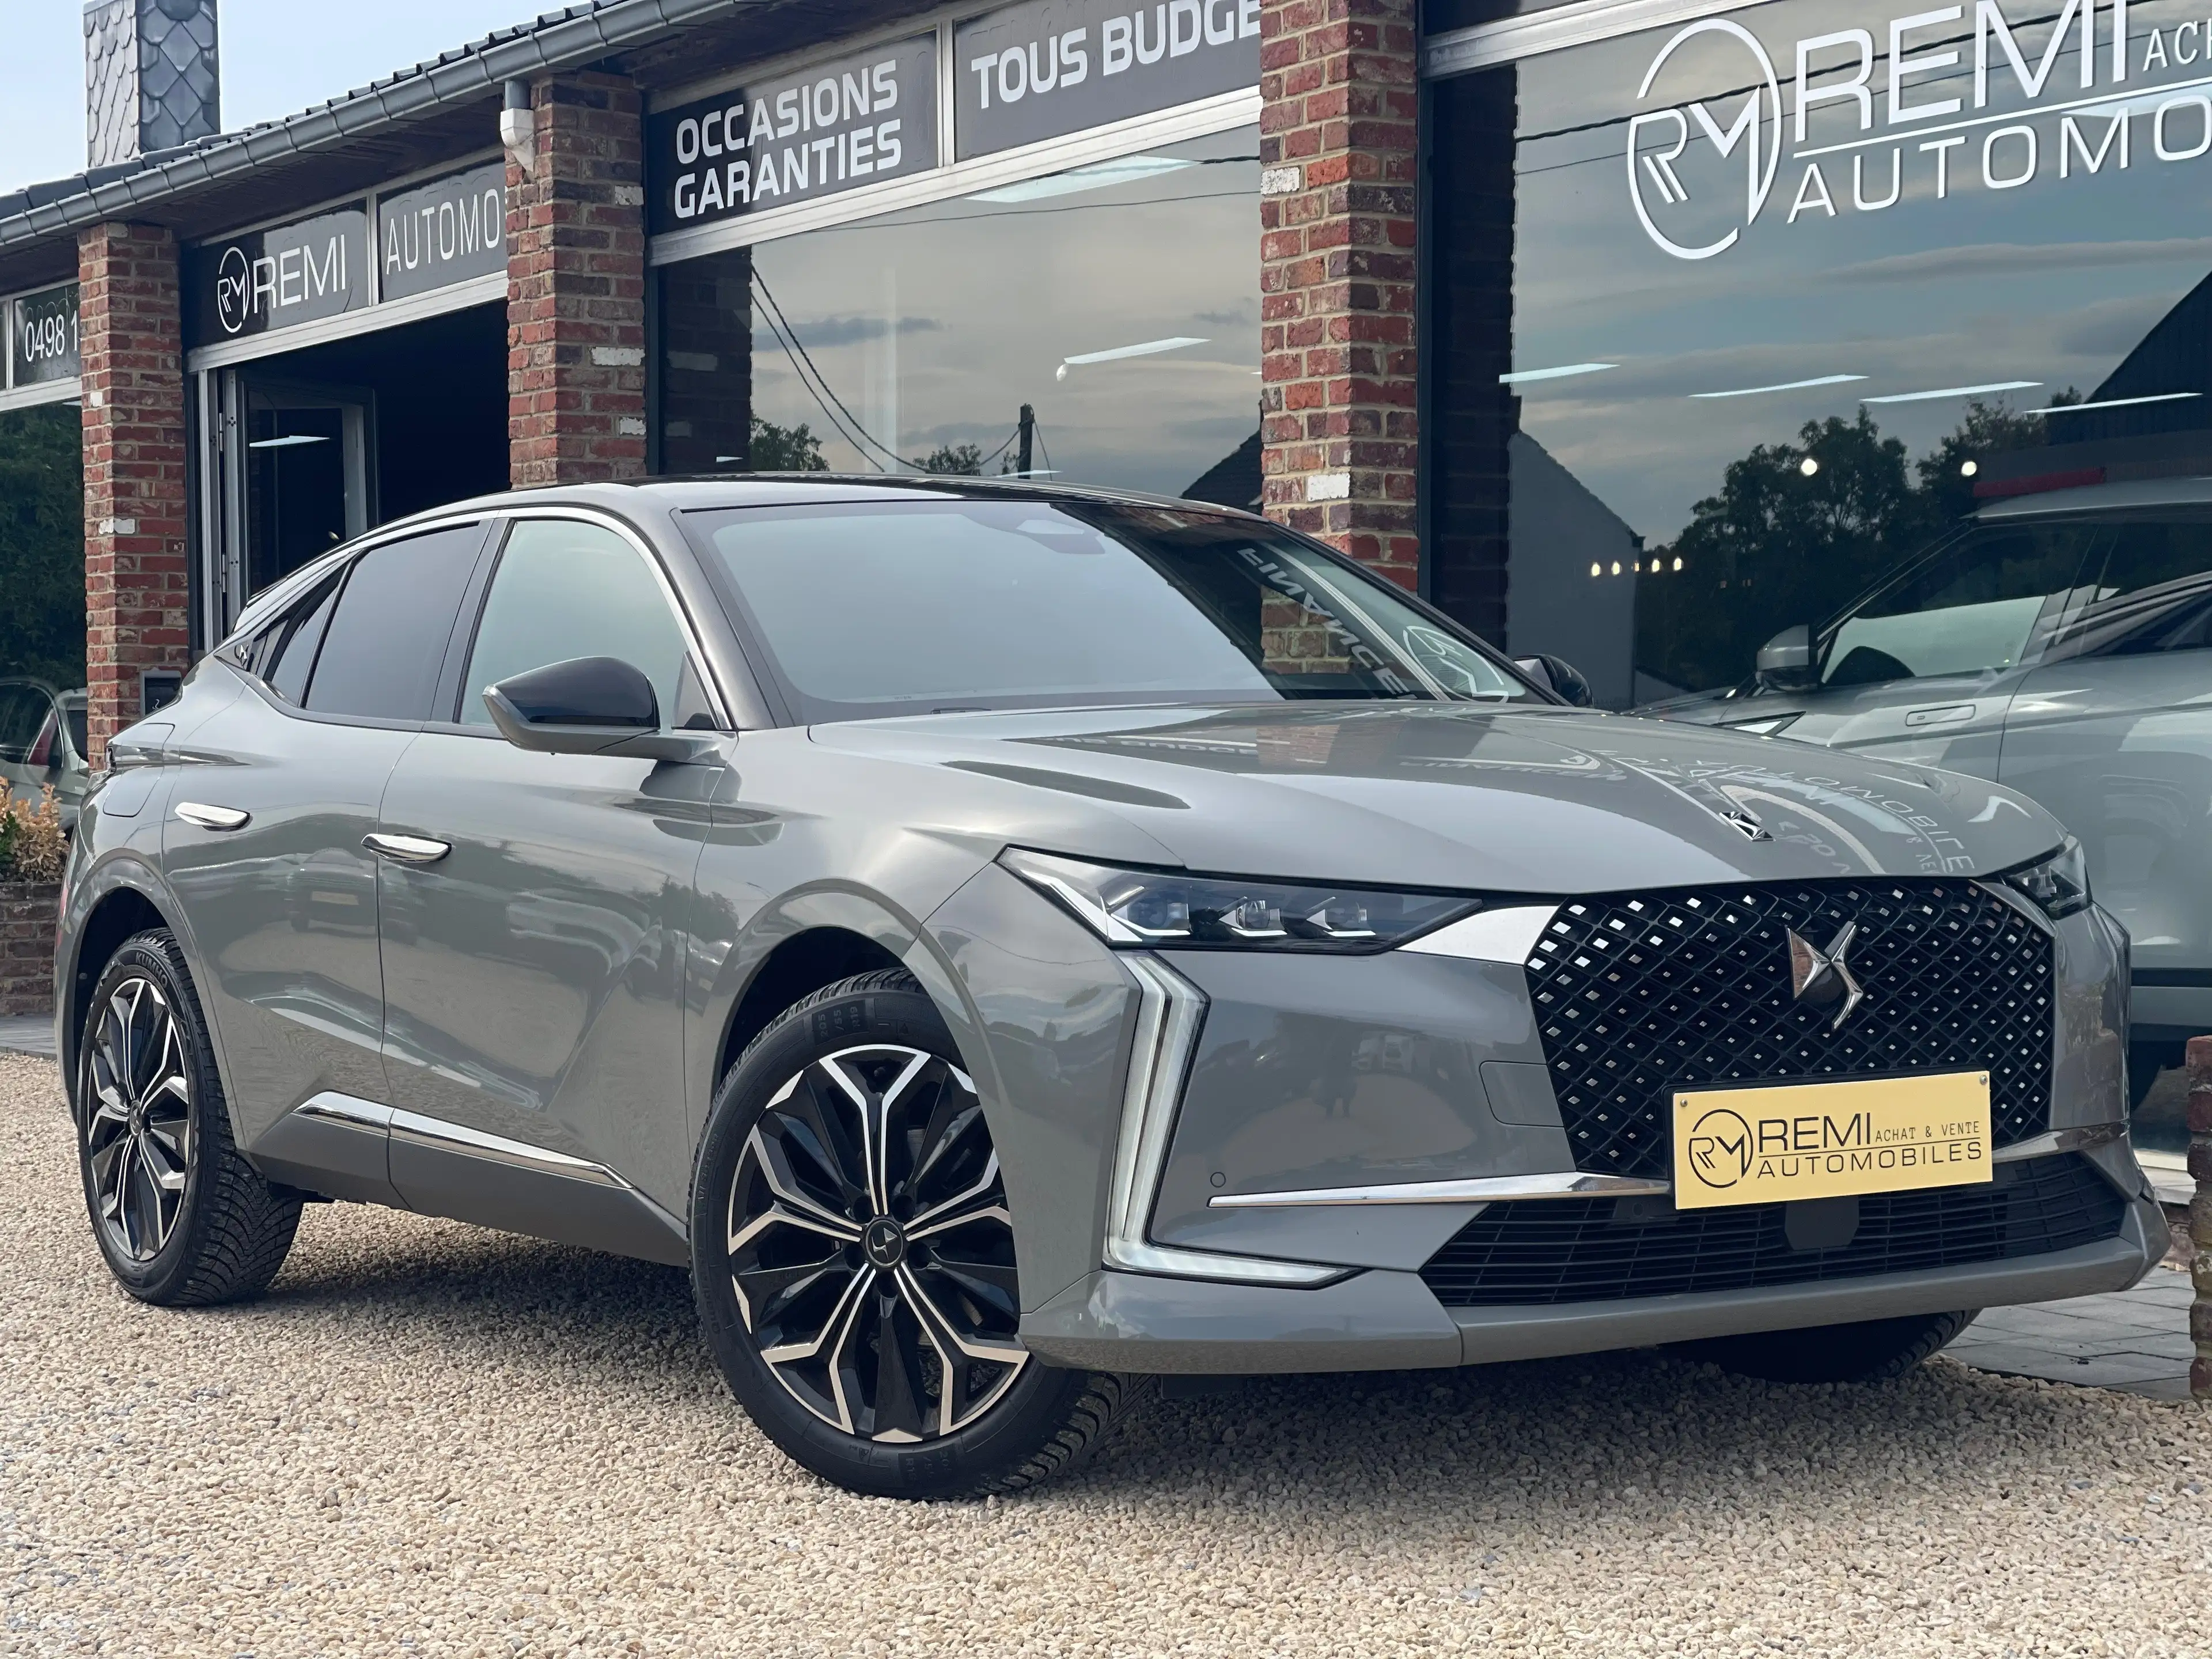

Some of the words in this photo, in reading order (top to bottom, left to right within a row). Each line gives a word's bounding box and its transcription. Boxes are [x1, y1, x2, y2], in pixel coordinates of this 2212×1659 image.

[971, 27, 1088, 109] TOUS
[1796, 0, 2126, 142] REMI
[676, 59, 897, 164] OCCASIONS
[675, 119, 902, 218] GARANTIES
[1786, 94, 2212, 224] AUTOMO
[386, 189, 501, 274] AUTOMO
[253, 233, 346, 314] REMI
[25, 314, 65, 362] 0498
[71, 310, 78, 351] 1
[135, 952, 168, 988] KUMHO
[1758, 1112, 1871, 1153] REMI
[1758, 1141, 1982, 1179] AUTOMOBILES
[1876, 1127, 1916, 1143] ACHAT
[1925, 1126, 1933, 1138] &
[1941, 1121, 1980, 1136] VENTE
